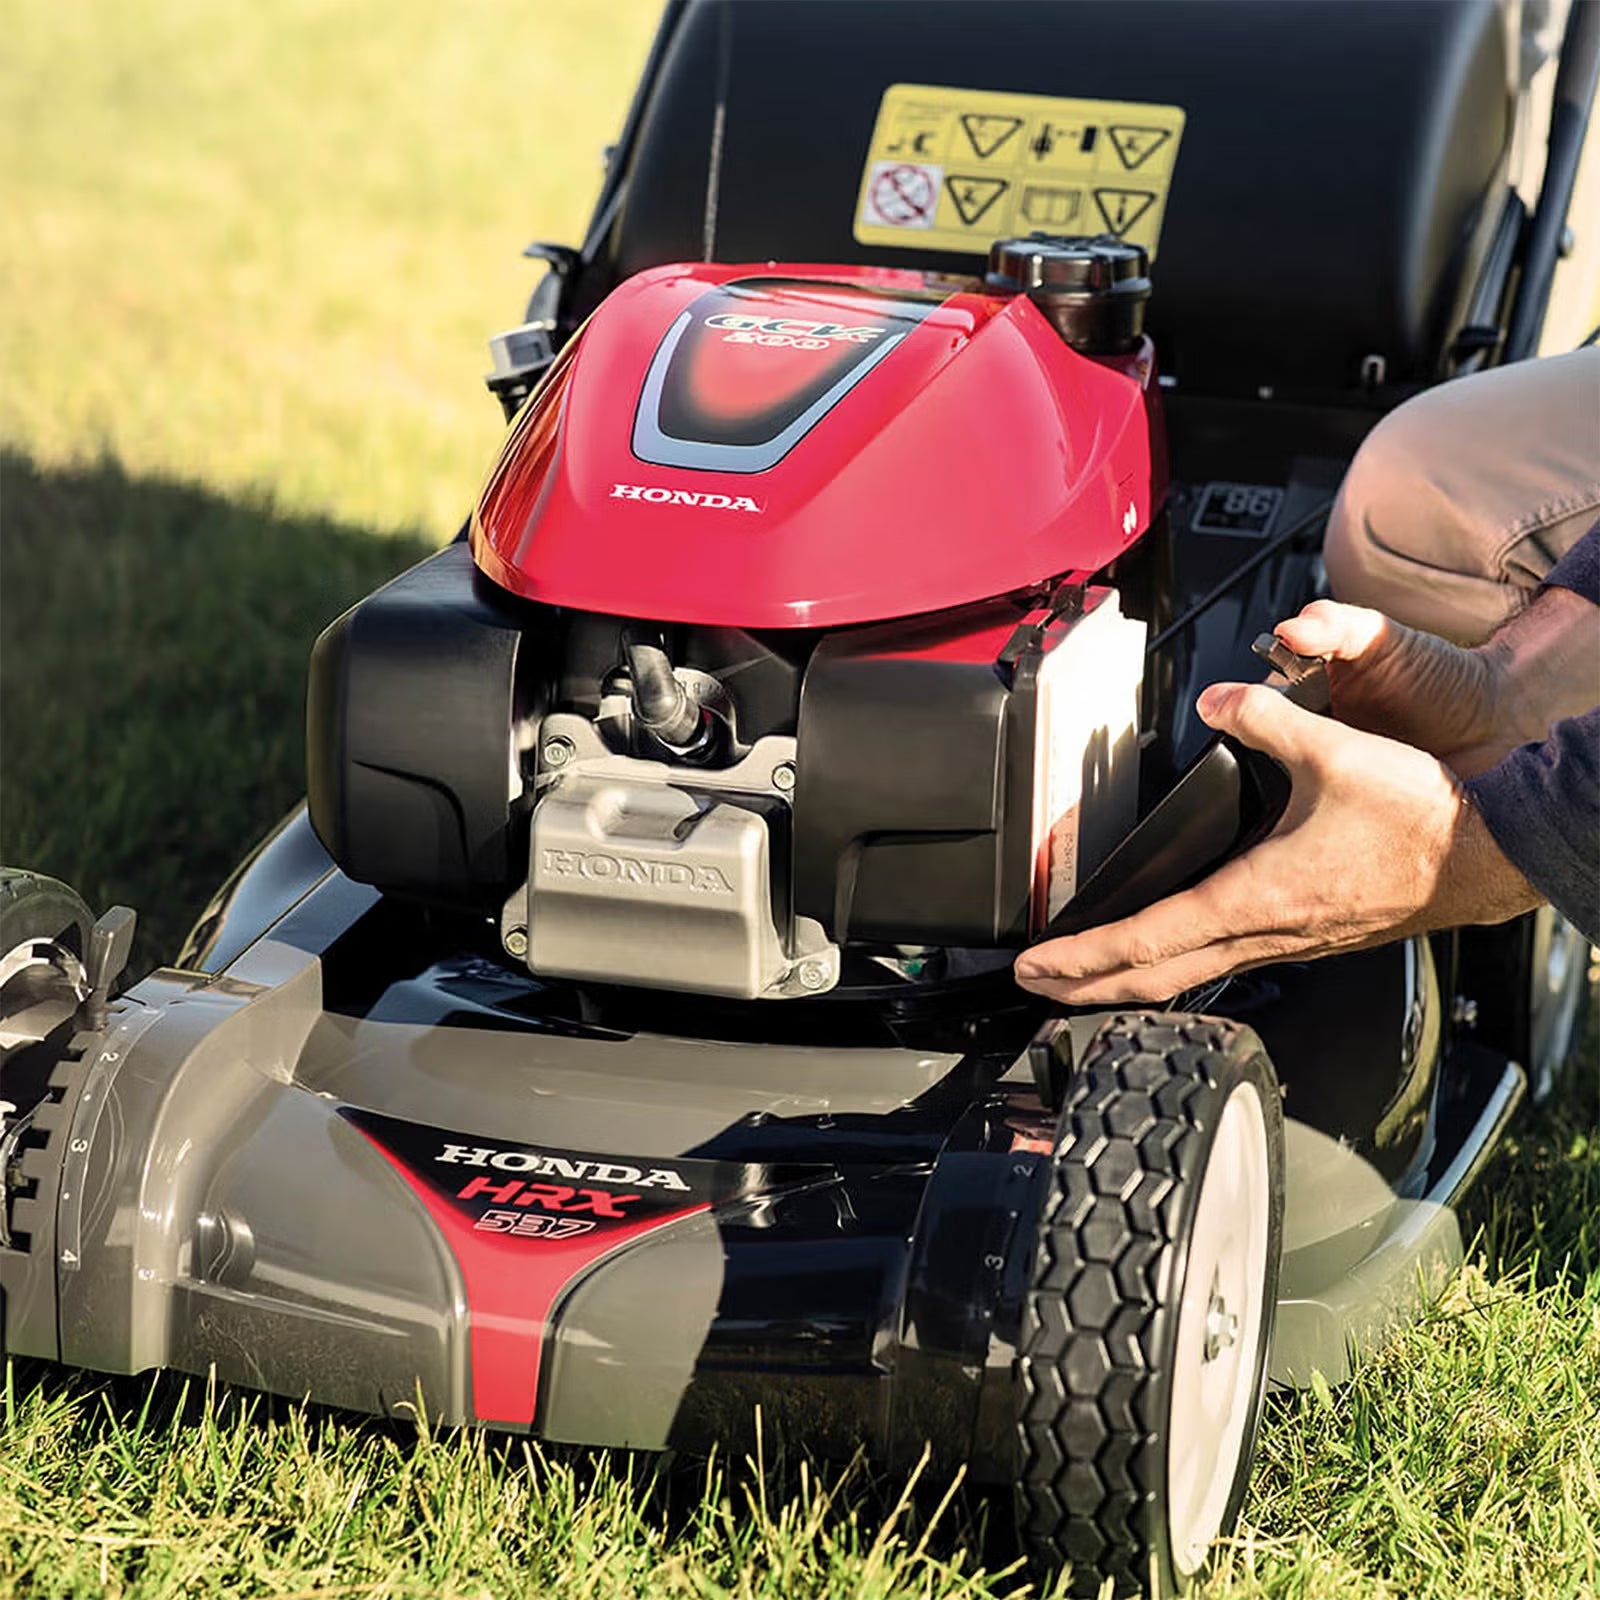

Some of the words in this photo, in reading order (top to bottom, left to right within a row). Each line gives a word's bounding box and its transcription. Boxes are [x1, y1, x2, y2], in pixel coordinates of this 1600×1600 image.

[609, 484, 761, 512] HONDA
[543, 848, 734, 895] HONDA
[100, 1051, 119, 1063] 2
[71, 1138, 88, 1153] 3
[434, 1143, 691, 1192] HONDA
[1013, 1163, 1033, 1177] 2
[457, 1176, 641, 1218] HRX
[473, 1209, 596, 1240] 537
[60, 1249, 78, 1263] 4
[984, 1253, 1004, 1271] 3
